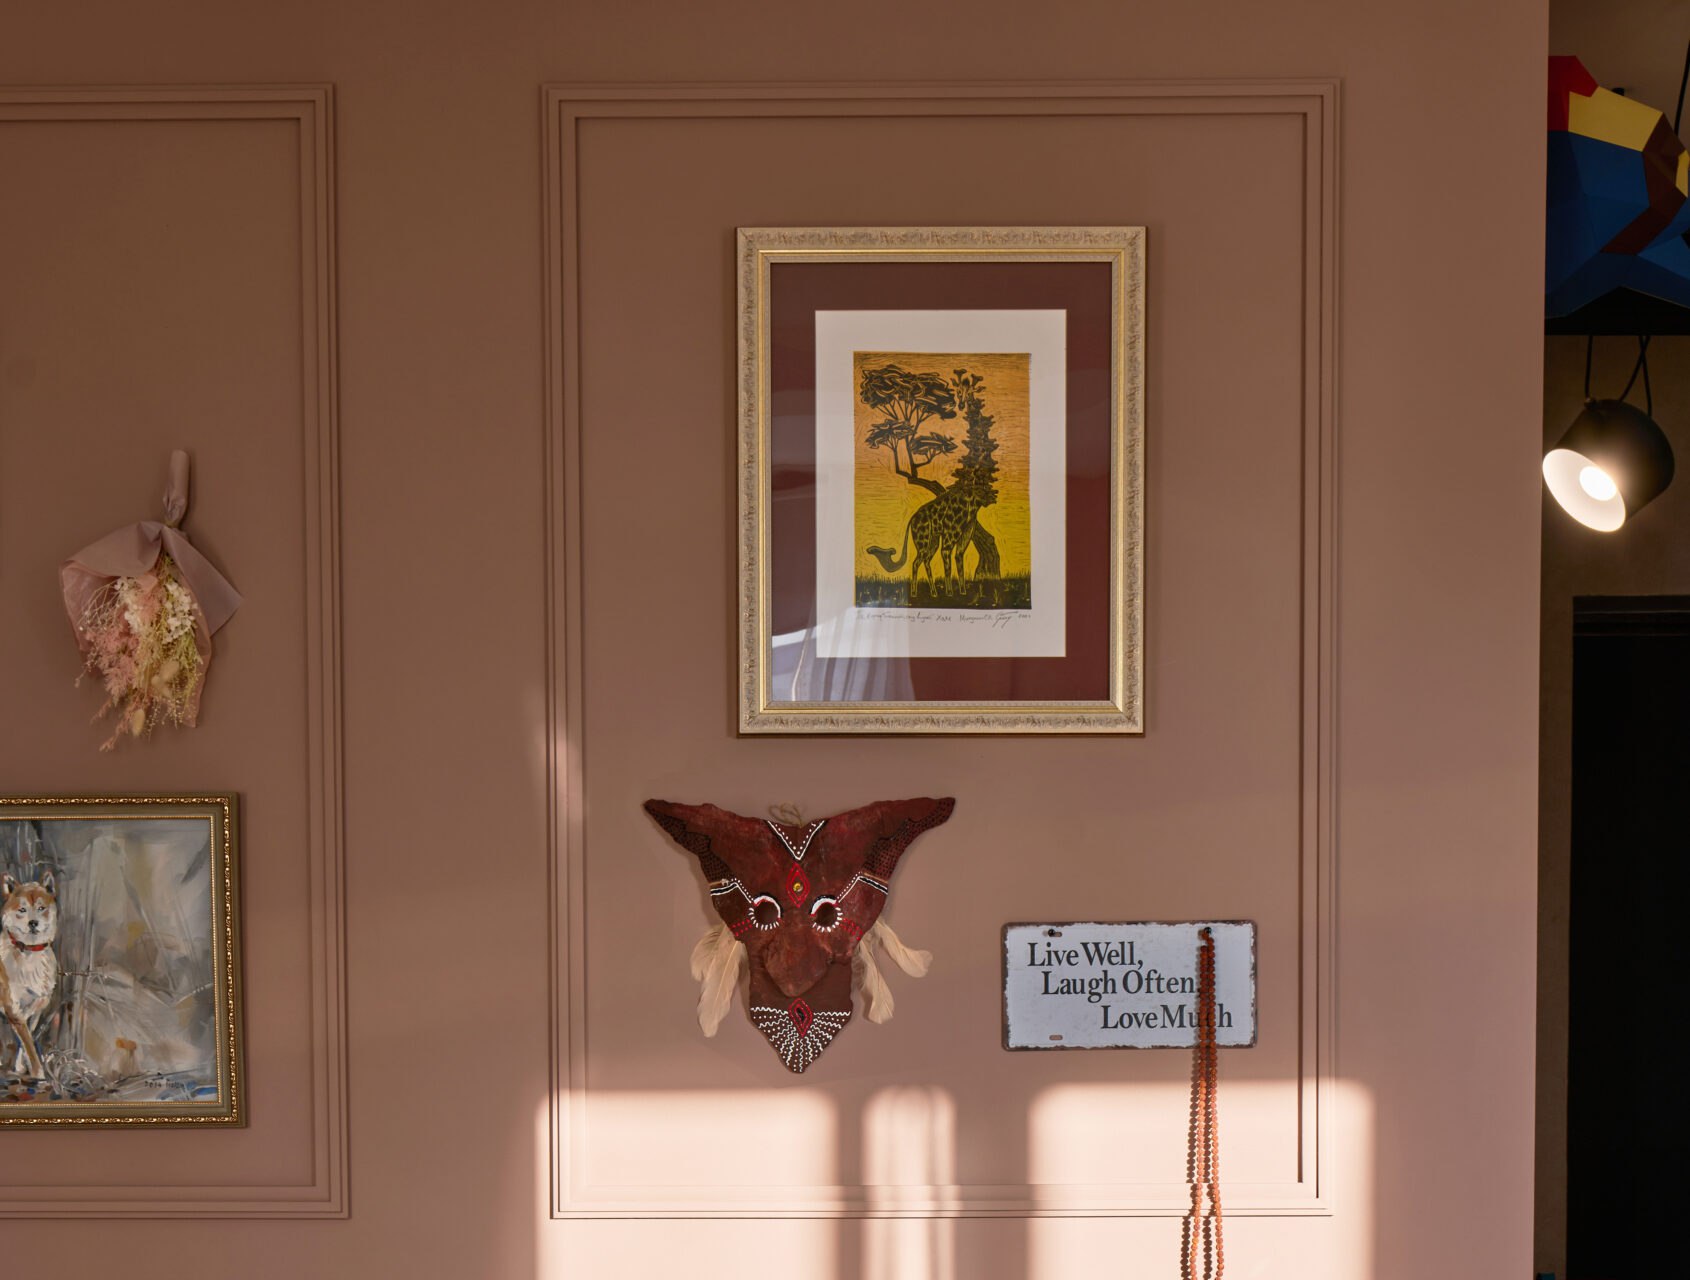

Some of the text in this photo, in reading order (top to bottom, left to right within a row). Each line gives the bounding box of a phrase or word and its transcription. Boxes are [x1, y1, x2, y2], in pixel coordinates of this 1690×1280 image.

[1027, 941, 1144, 970] Live Well,
[1041, 970, 1118, 1004] Laugh
[1100, 1003, 1233, 1029] Love Muh
